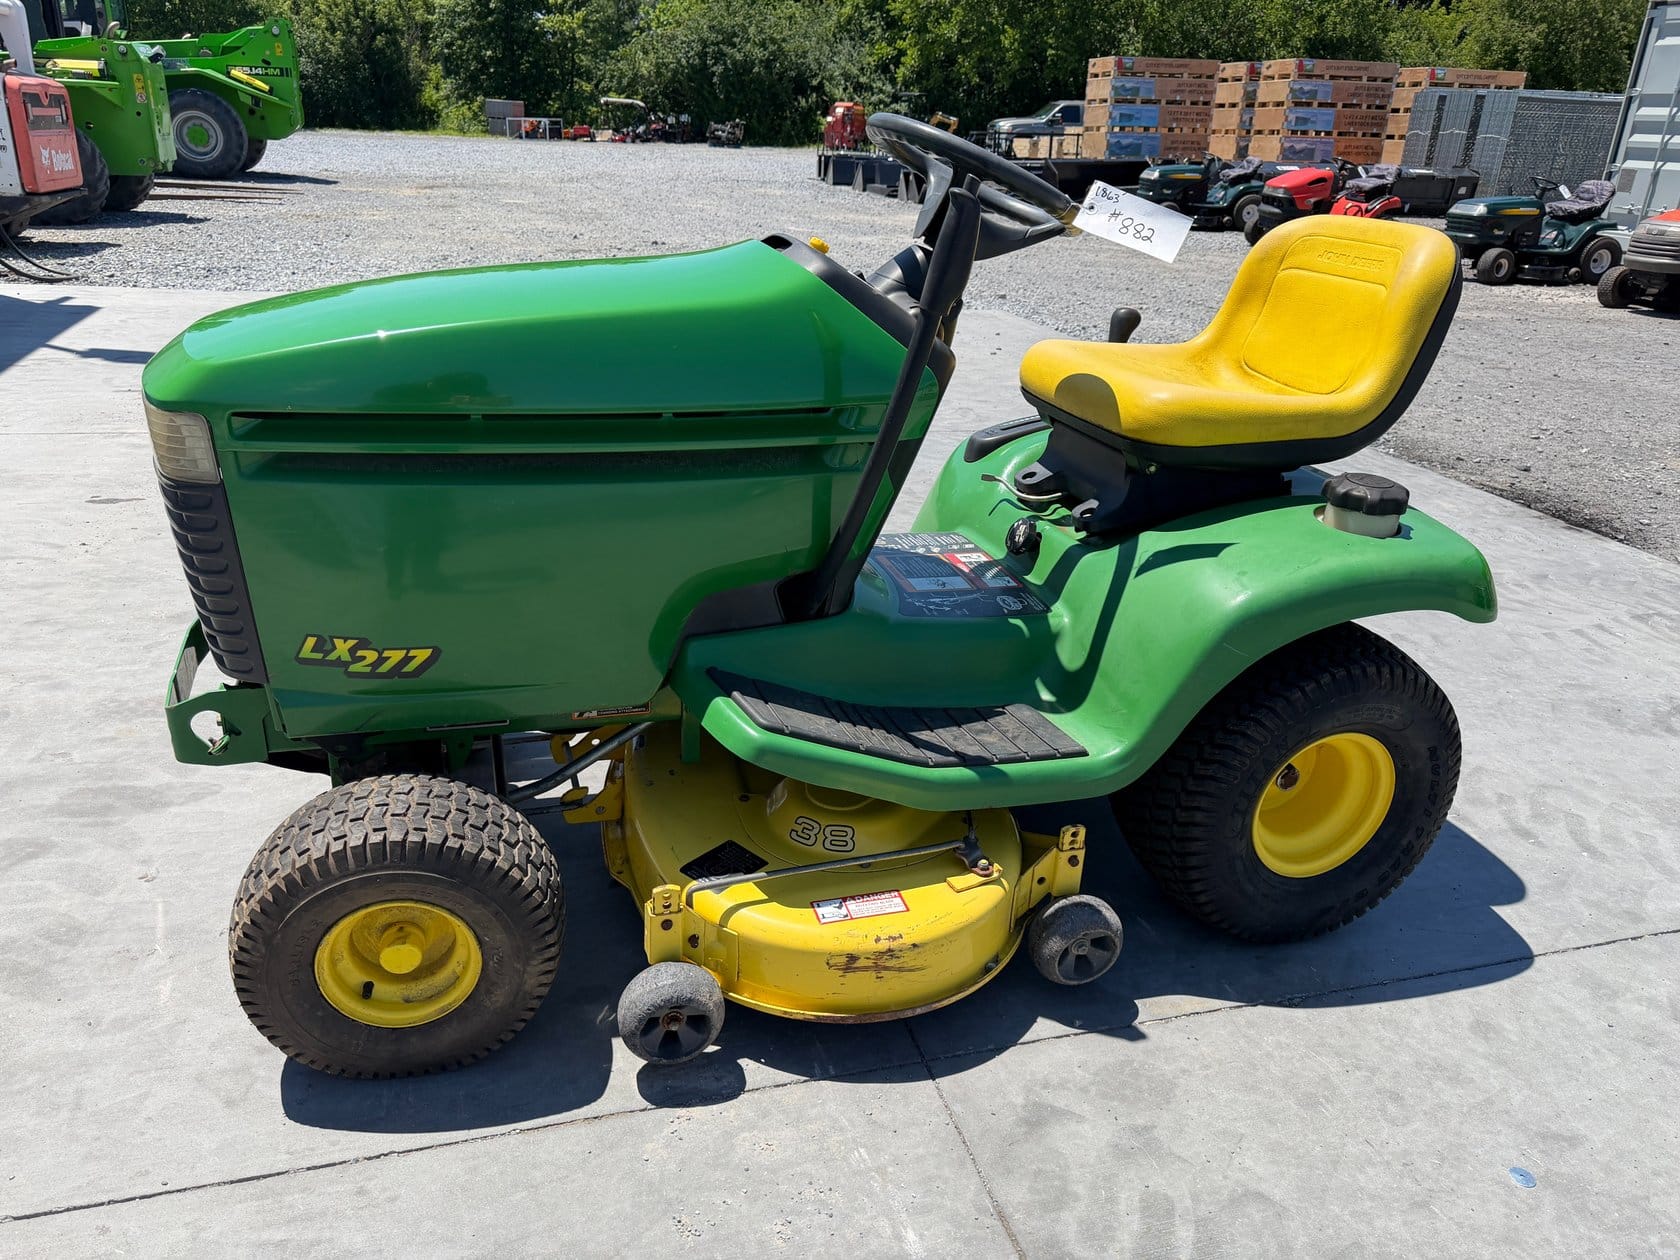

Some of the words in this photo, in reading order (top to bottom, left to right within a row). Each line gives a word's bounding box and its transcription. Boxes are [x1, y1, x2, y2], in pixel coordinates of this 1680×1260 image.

[1107, 208, 1155, 243] #882
[789, 815, 856, 853] 38
[855, 890, 899, 903] DANGER
